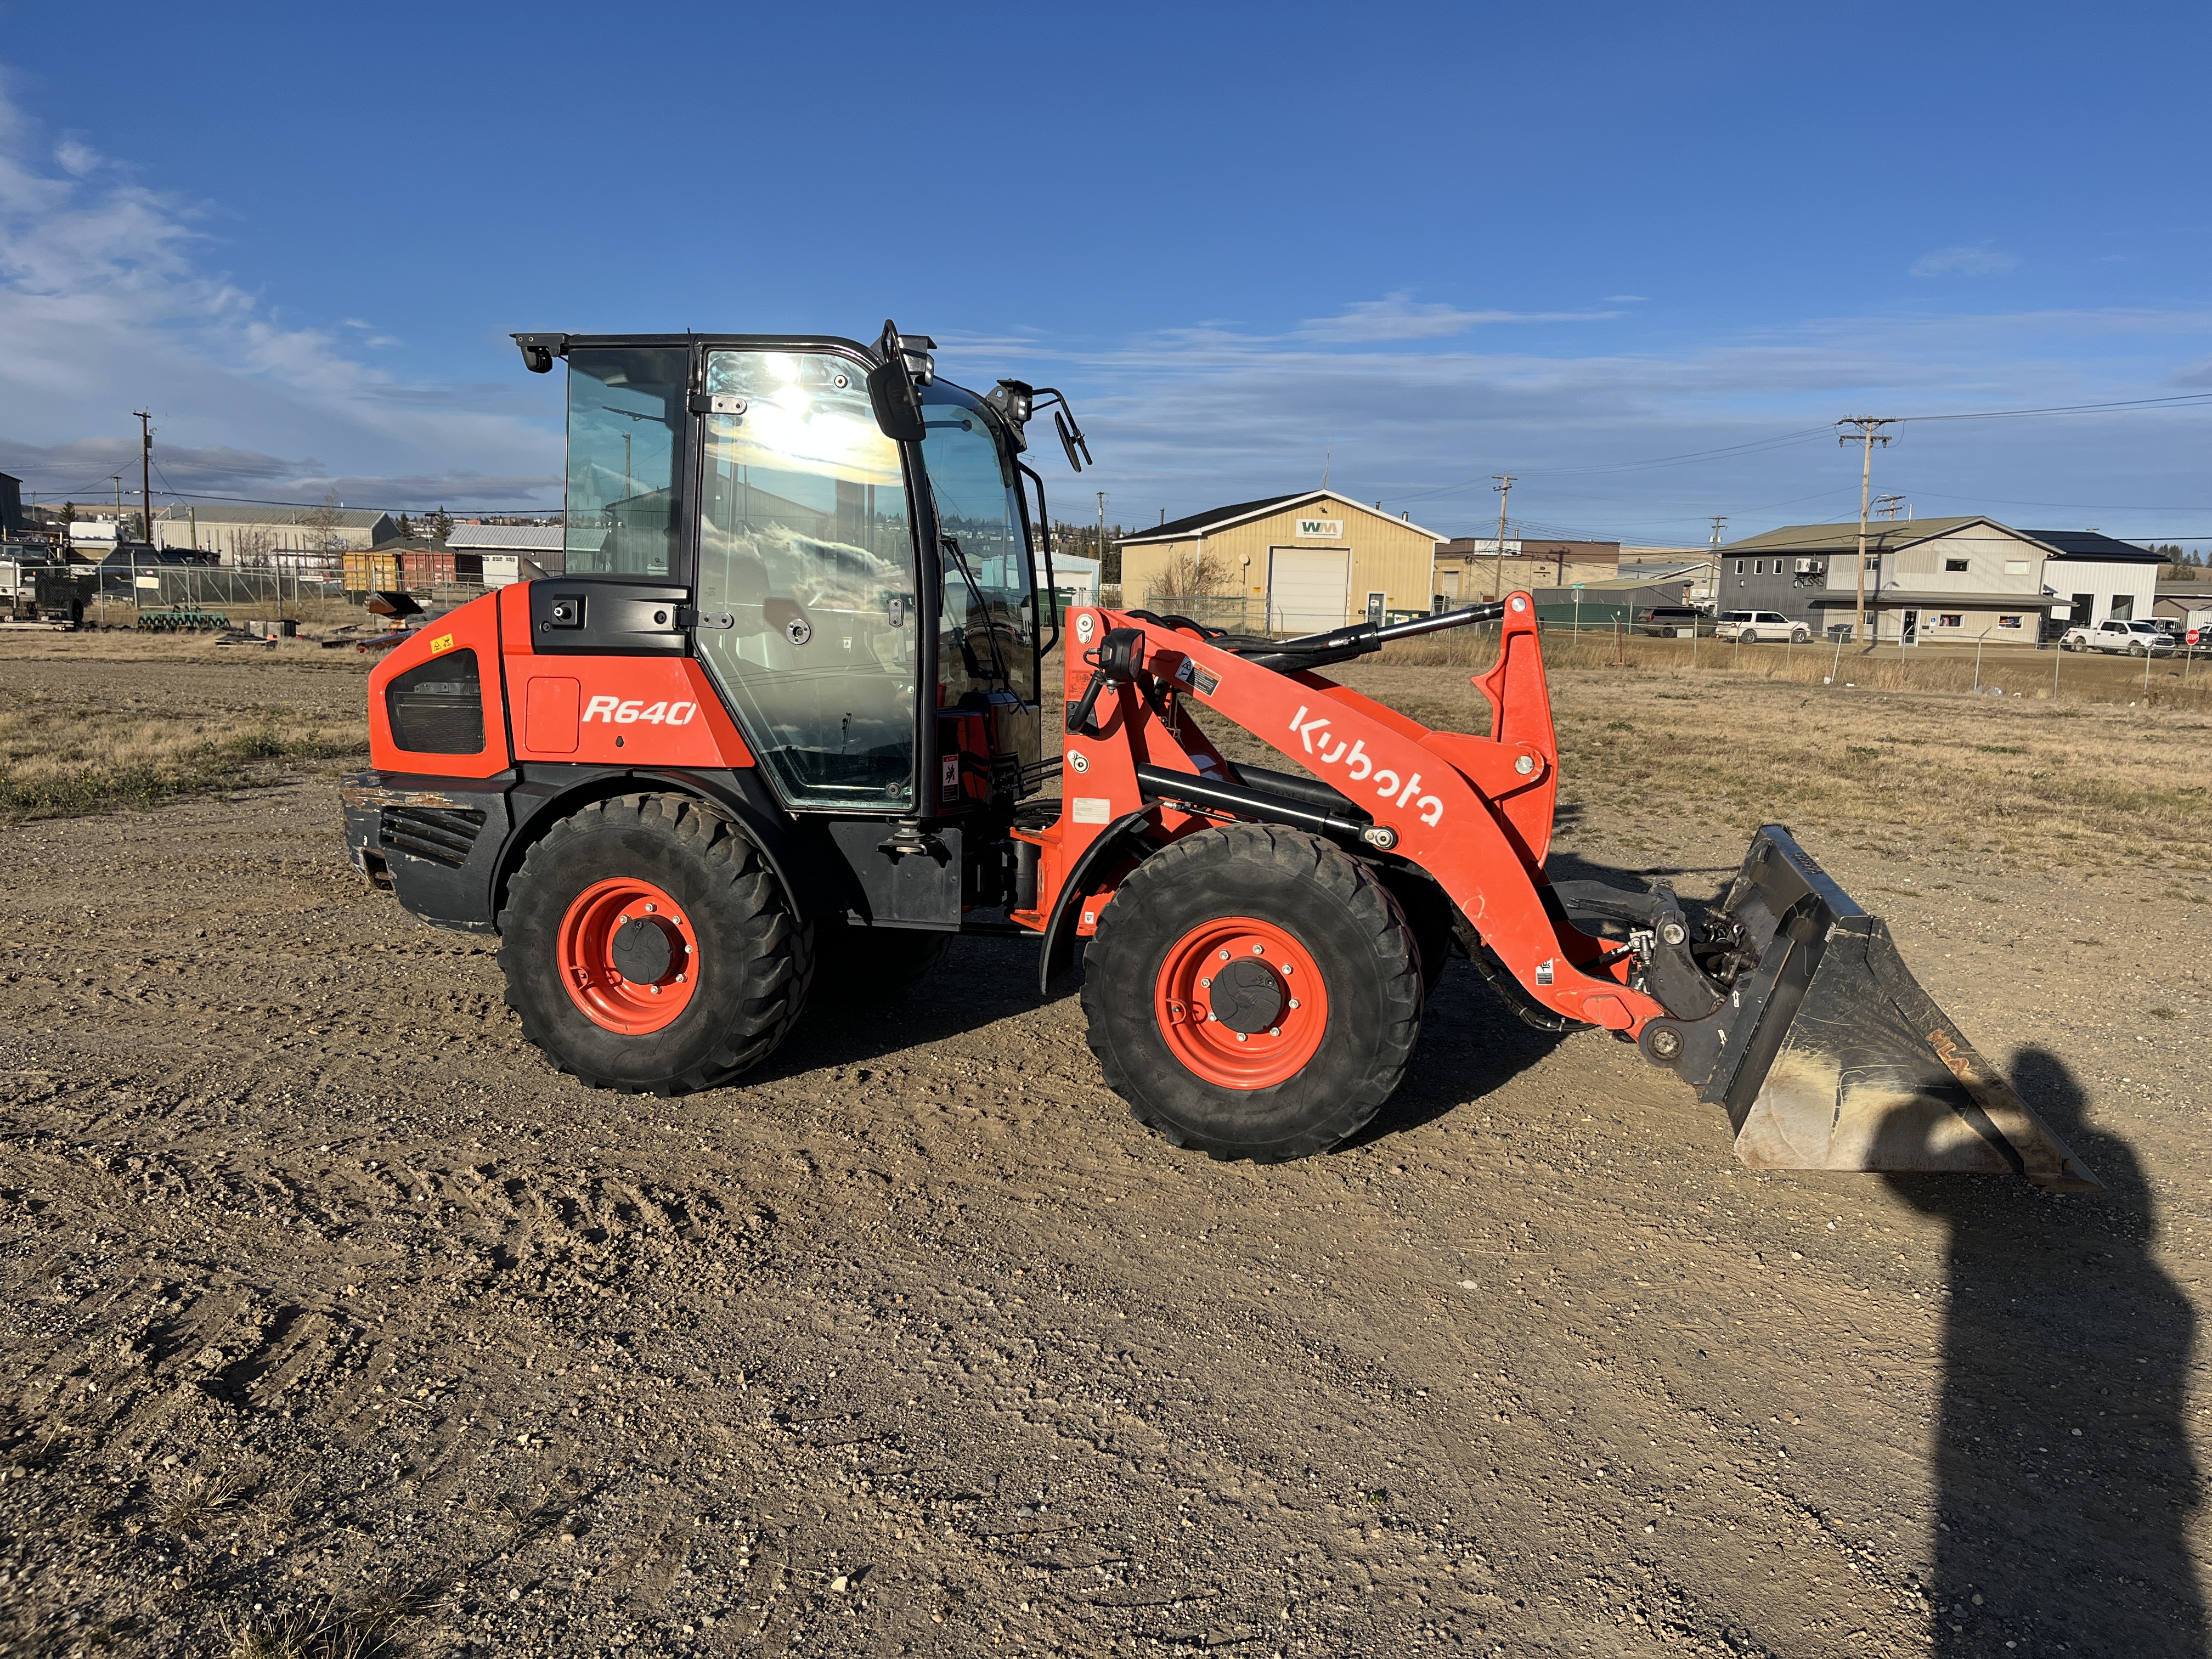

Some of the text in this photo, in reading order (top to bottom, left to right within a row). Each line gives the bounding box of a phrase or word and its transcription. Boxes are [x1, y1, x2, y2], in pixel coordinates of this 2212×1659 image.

[1302, 522, 1337, 533] WM
[582, 696, 696, 725] R640
[1288, 705, 1443, 827] Kubota
[1926, 1027, 1970, 1076] HLA
